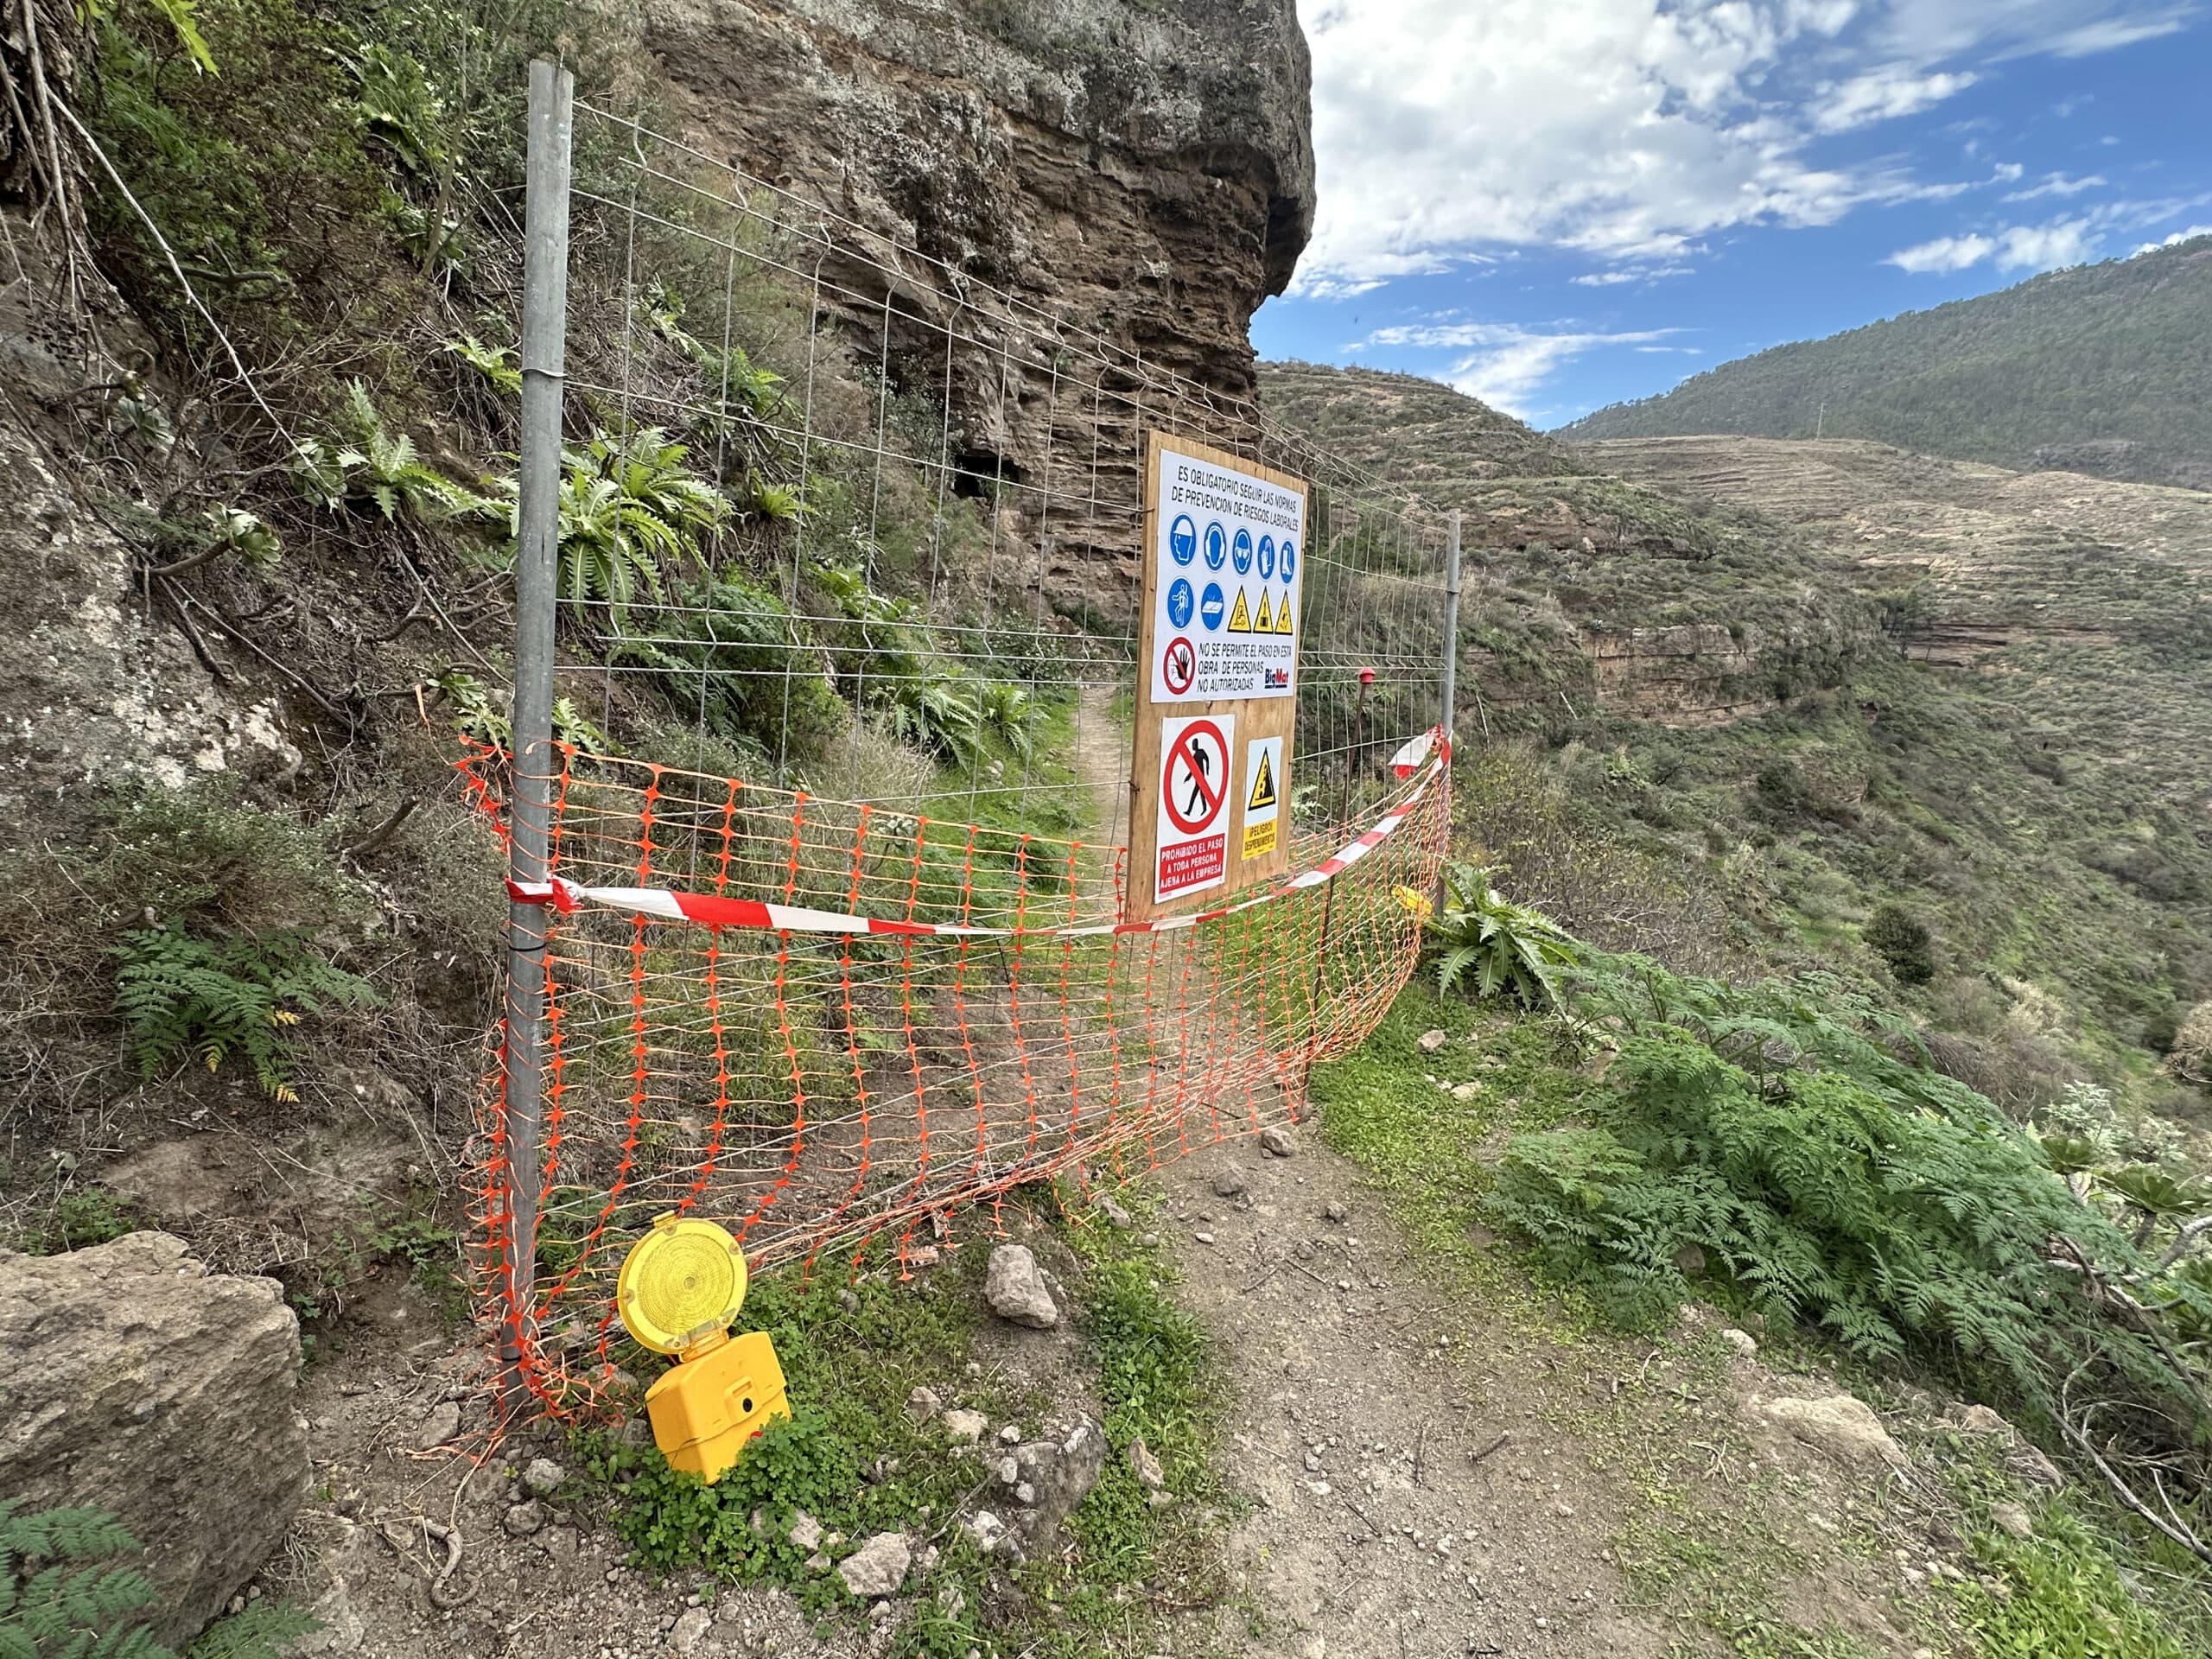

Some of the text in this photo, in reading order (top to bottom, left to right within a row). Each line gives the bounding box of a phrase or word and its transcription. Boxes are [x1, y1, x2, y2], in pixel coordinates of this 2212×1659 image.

[1178, 466, 1296, 513] ES OBLIGATORIO SEGUIR LAS NORMAS
[1172, 486, 1299, 531] DE PREVENCION DE RIESGOS LABORALES
[1198, 643, 1292, 657] NO SE PERMITE EL PASO EN ESTA
[1198, 661, 1263, 674] OBRA DE PERSONAS
[1265, 668, 1288, 687] BigMat
[1198, 677, 1254, 692] NO AUTORIZADAS
[1161, 837, 1223, 861] PROHIBIDO EL PASO
[1166, 853, 1217, 874] A TODA PERSONA
[1160, 863, 1221, 889] AJENA A LA EMPRESA
